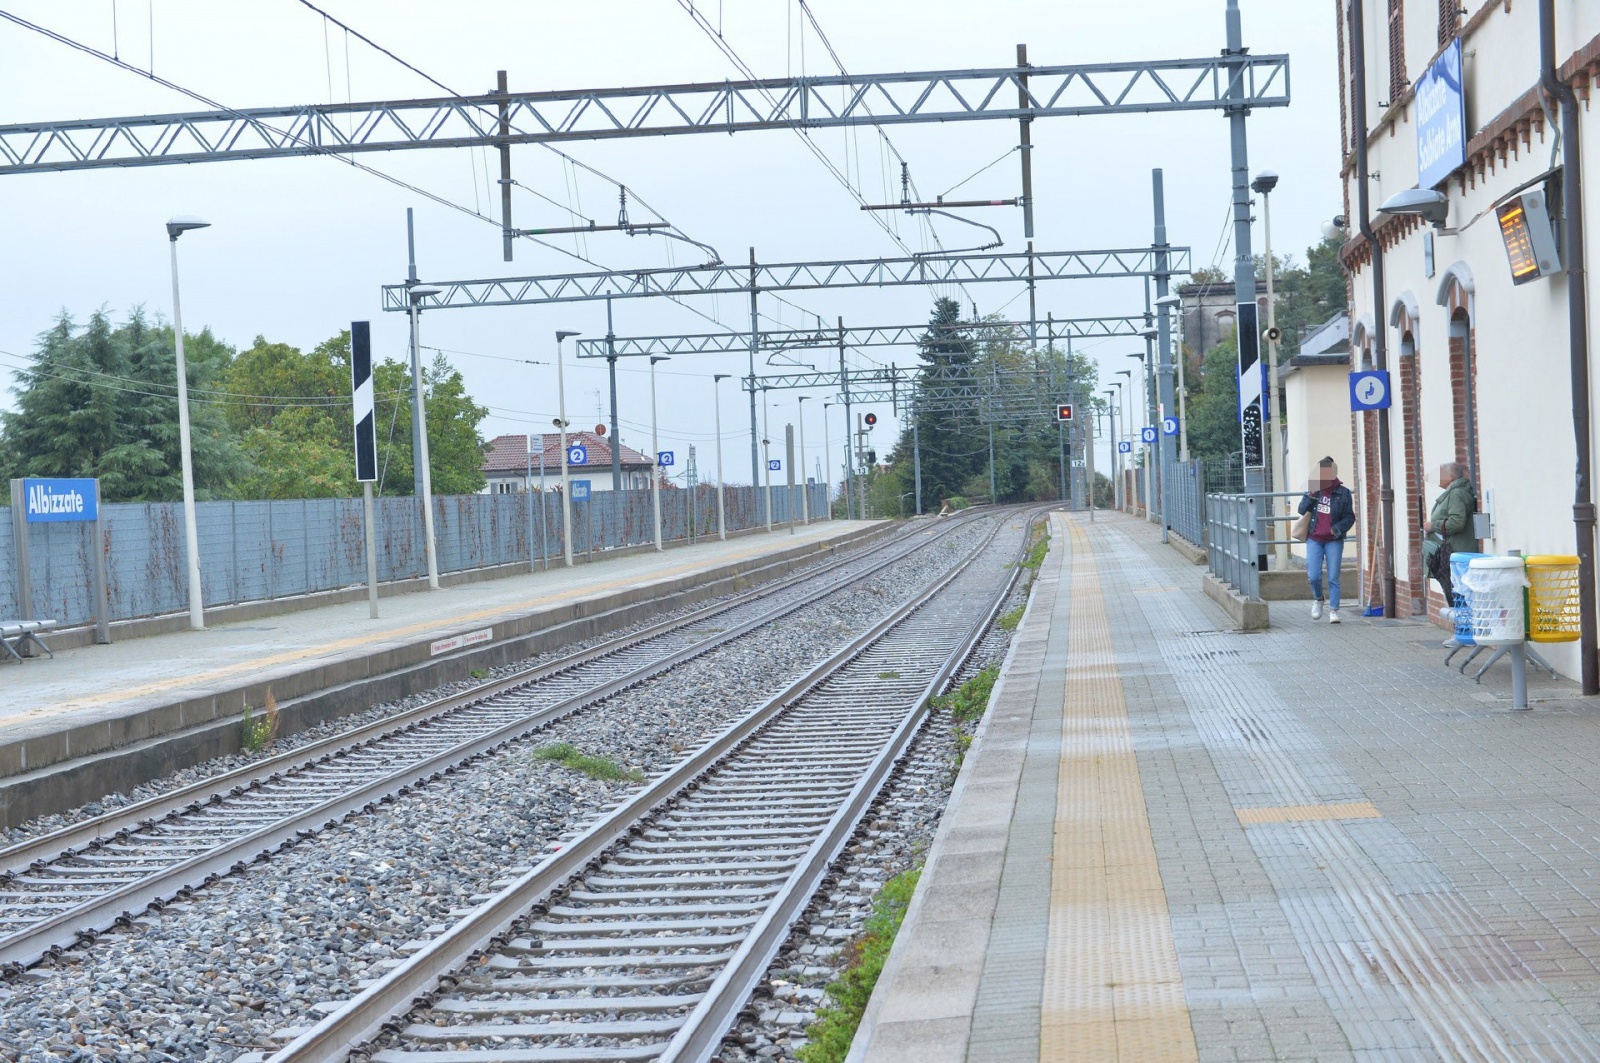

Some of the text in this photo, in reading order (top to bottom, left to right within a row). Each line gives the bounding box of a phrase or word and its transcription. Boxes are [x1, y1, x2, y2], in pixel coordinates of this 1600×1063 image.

[1419, 125, 1445, 173] Solbiate
[573, 451, 581, 461] 2
[857, 467, 866, 475] 13
[29, 484, 84, 514] Albizzate
